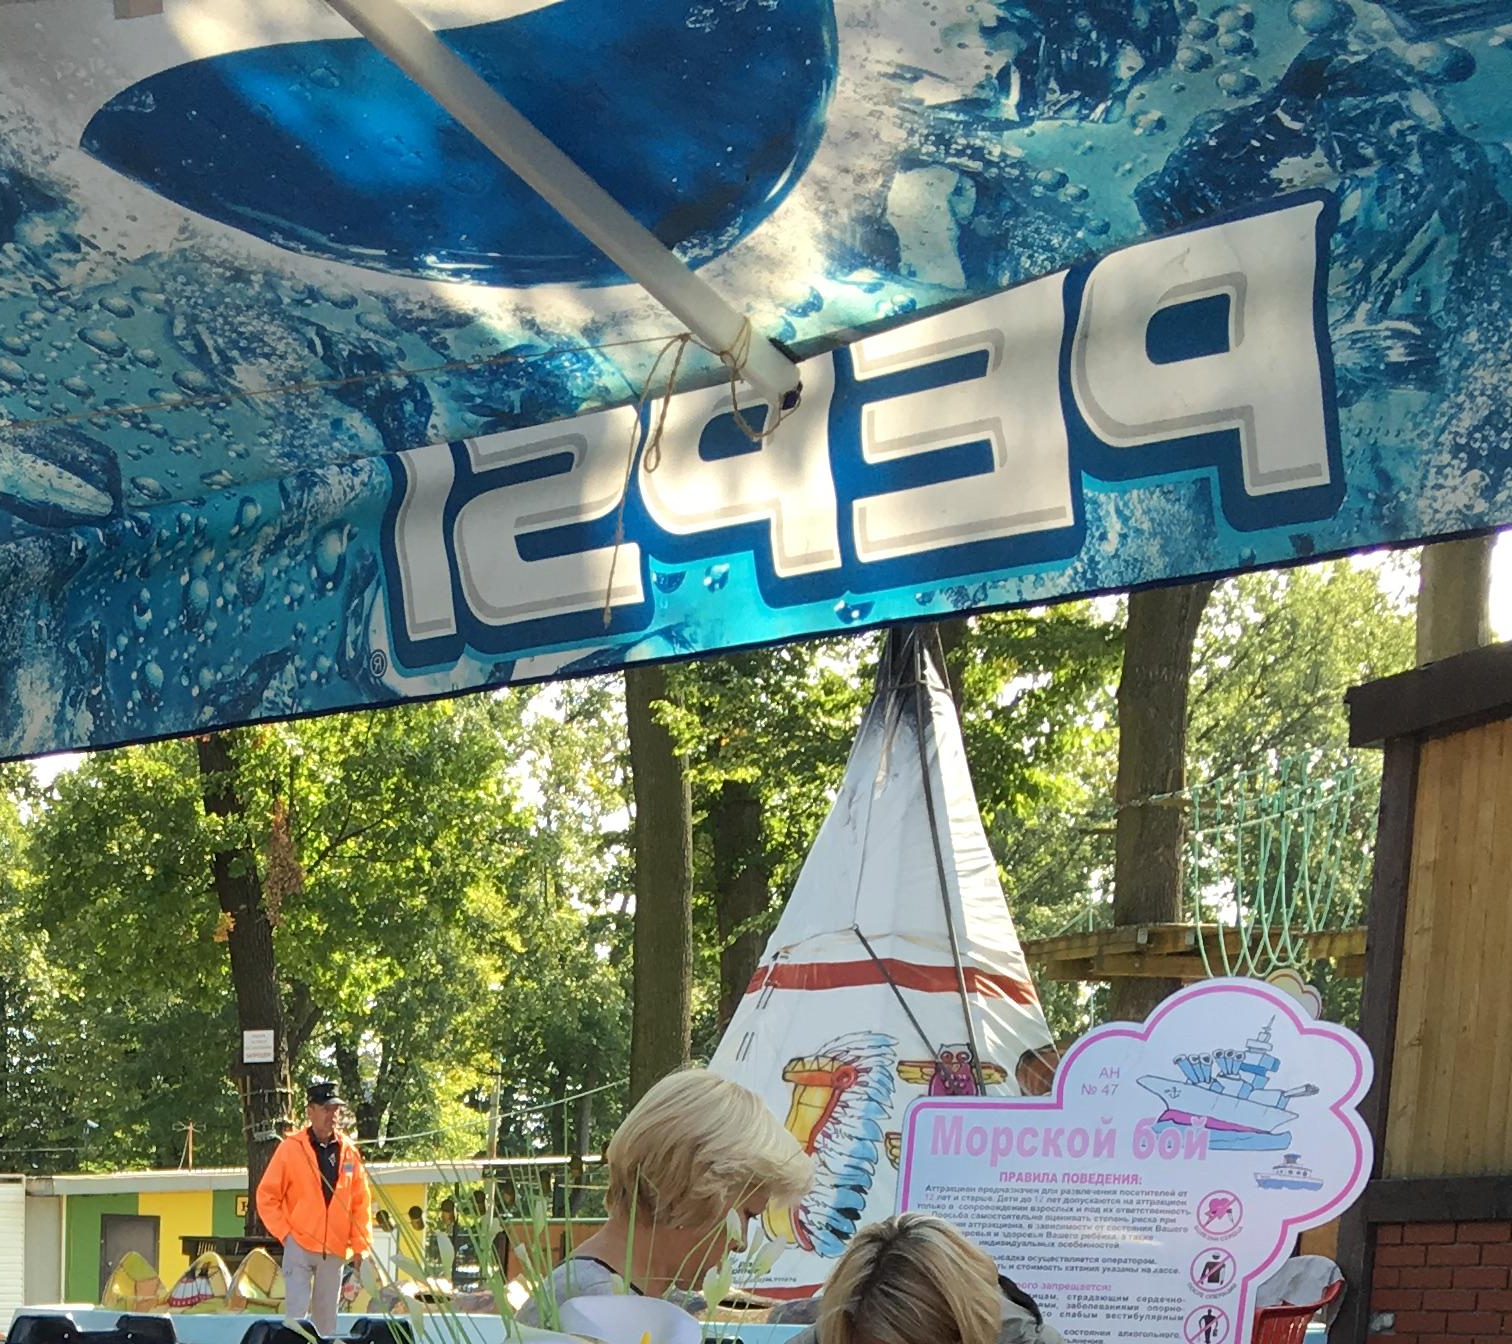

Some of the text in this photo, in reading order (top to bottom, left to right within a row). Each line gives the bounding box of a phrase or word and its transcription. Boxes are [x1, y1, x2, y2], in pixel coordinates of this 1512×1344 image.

[1099, 1067, 1120, 1079] АН
[1101, 1084, 1118, 1095] 47
[930, 1114, 1208, 1167] Морской бой
[999, 1172, 1142, 1187] ПРАВИЛА ПОВЕДЕНИЯ:
[926, 1184, 975, 1195] Аттракцион
[1041, 1188, 1058, 1196] для
[1067, 1294, 1129, 1302] страдающим
[1105, 1312, 1184, 1321] вестибулярным
